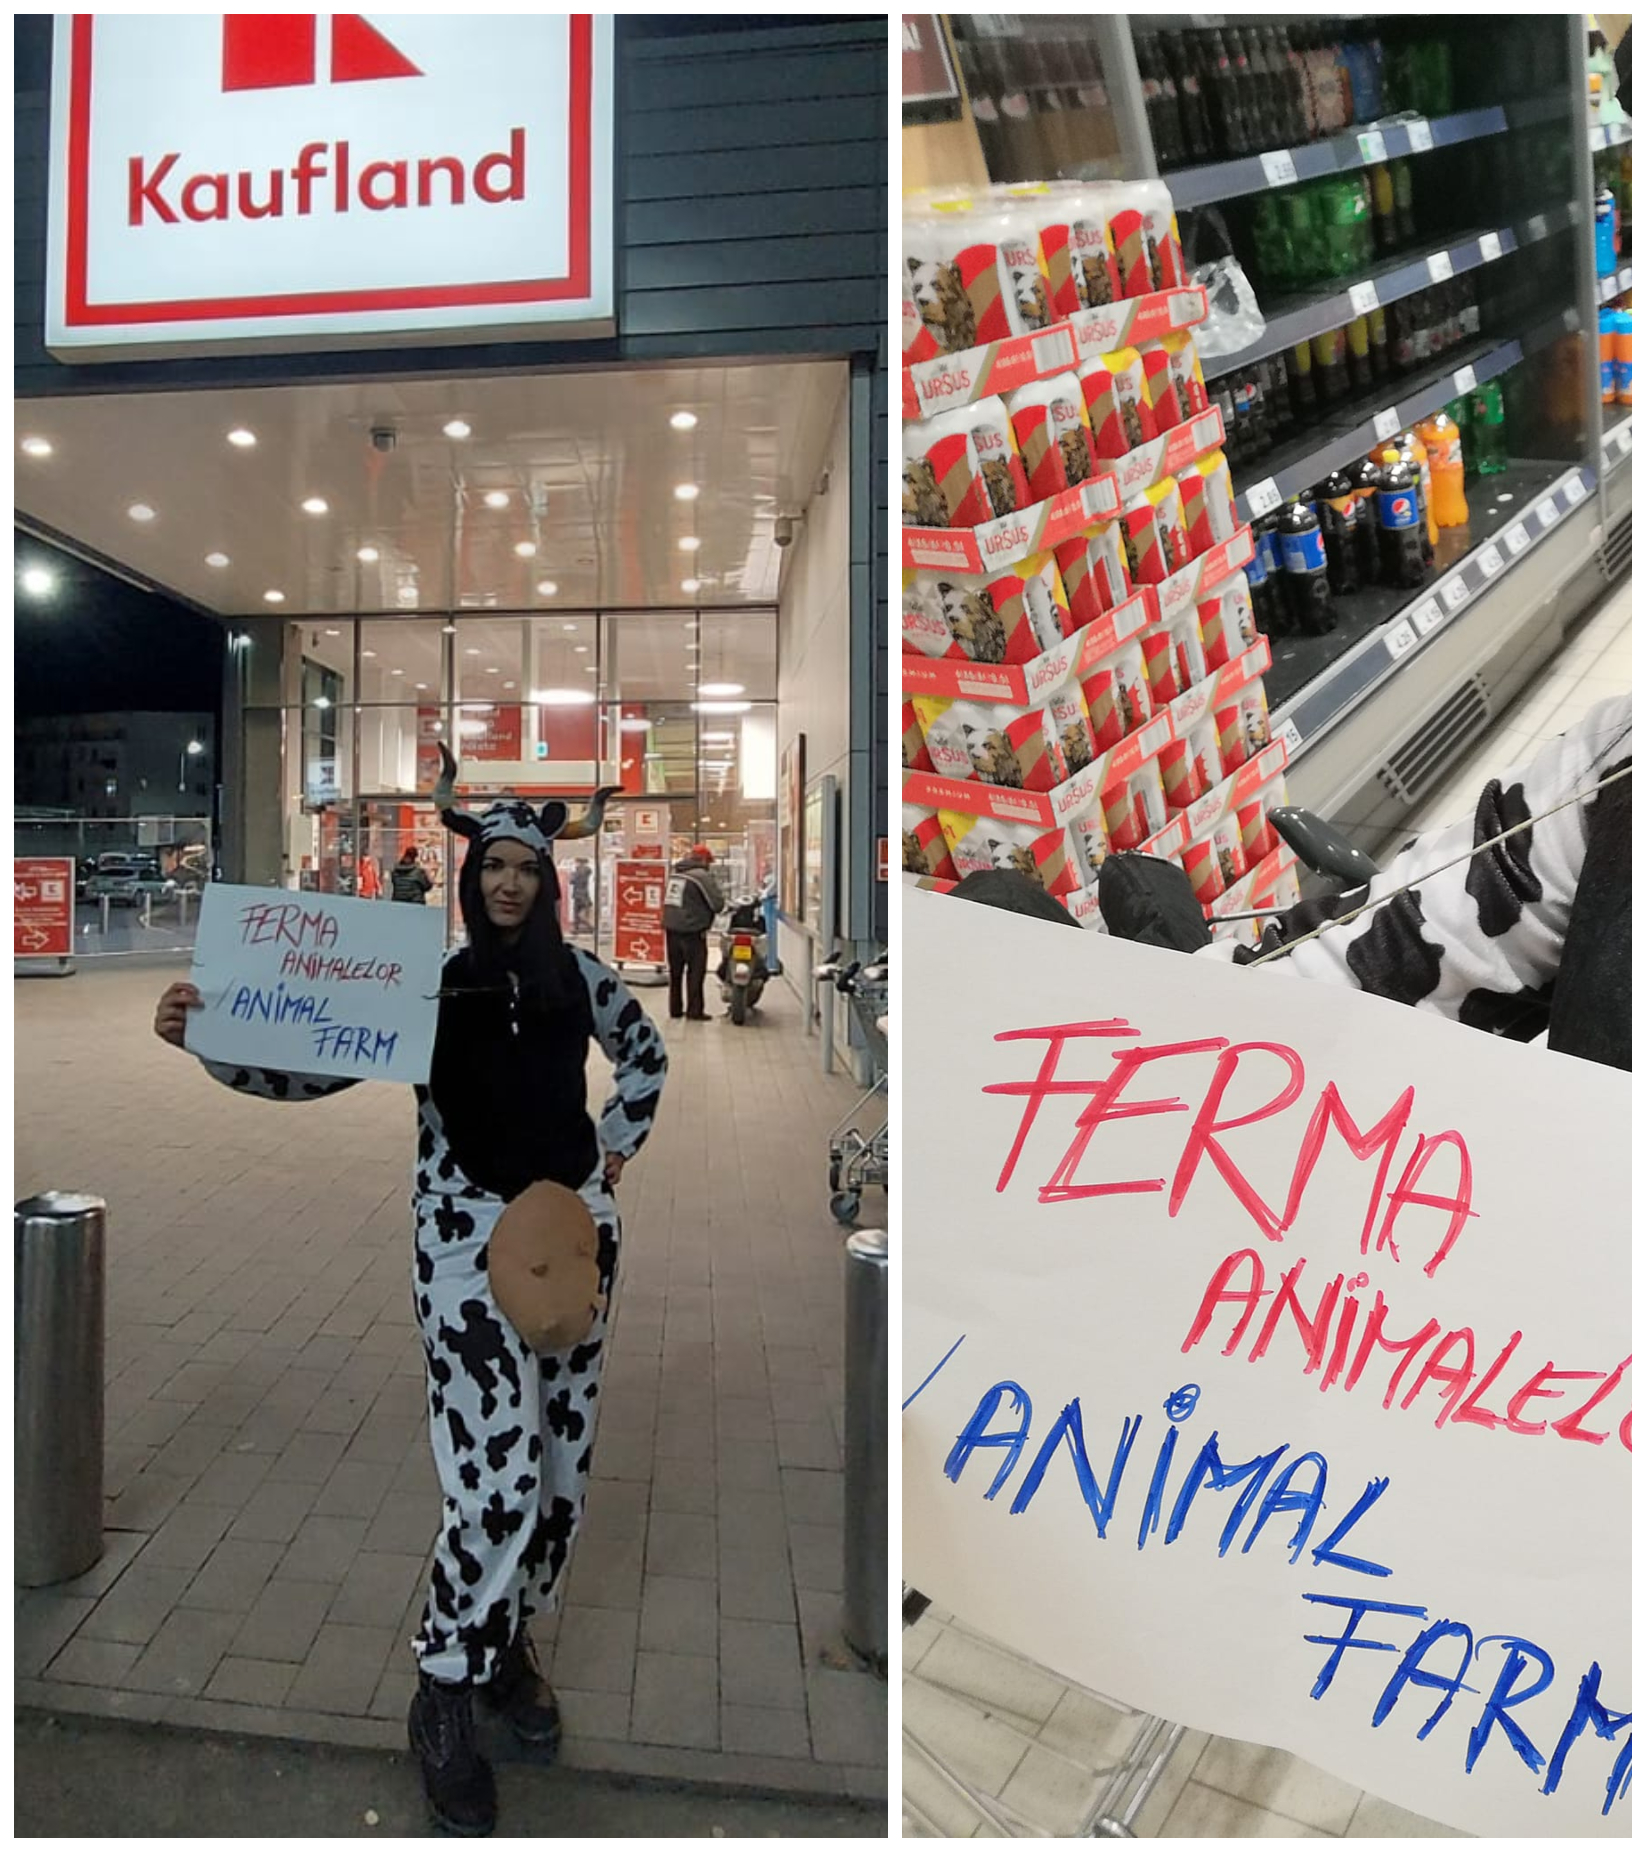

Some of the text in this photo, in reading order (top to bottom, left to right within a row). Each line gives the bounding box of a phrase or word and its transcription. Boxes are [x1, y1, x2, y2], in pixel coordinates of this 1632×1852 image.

[129, 129, 526, 227] Kaufland
[921, 369, 971, 400] URSUS
[985, 526, 1029, 555] URSUS
[1031, 656, 1068, 690] URSUS
[1057, 780, 1094, 813] URSUS
[240, 902, 339, 950] FERMA
[279, 948, 403, 990] ANIMALELOR
[231, 981, 333, 1025] ANIMAL
[312, 1025, 399, 1066] FARM
[981, 1017, 1480, 1279] FERMA
[944, 1380, 1393, 1577] ANIMAL
